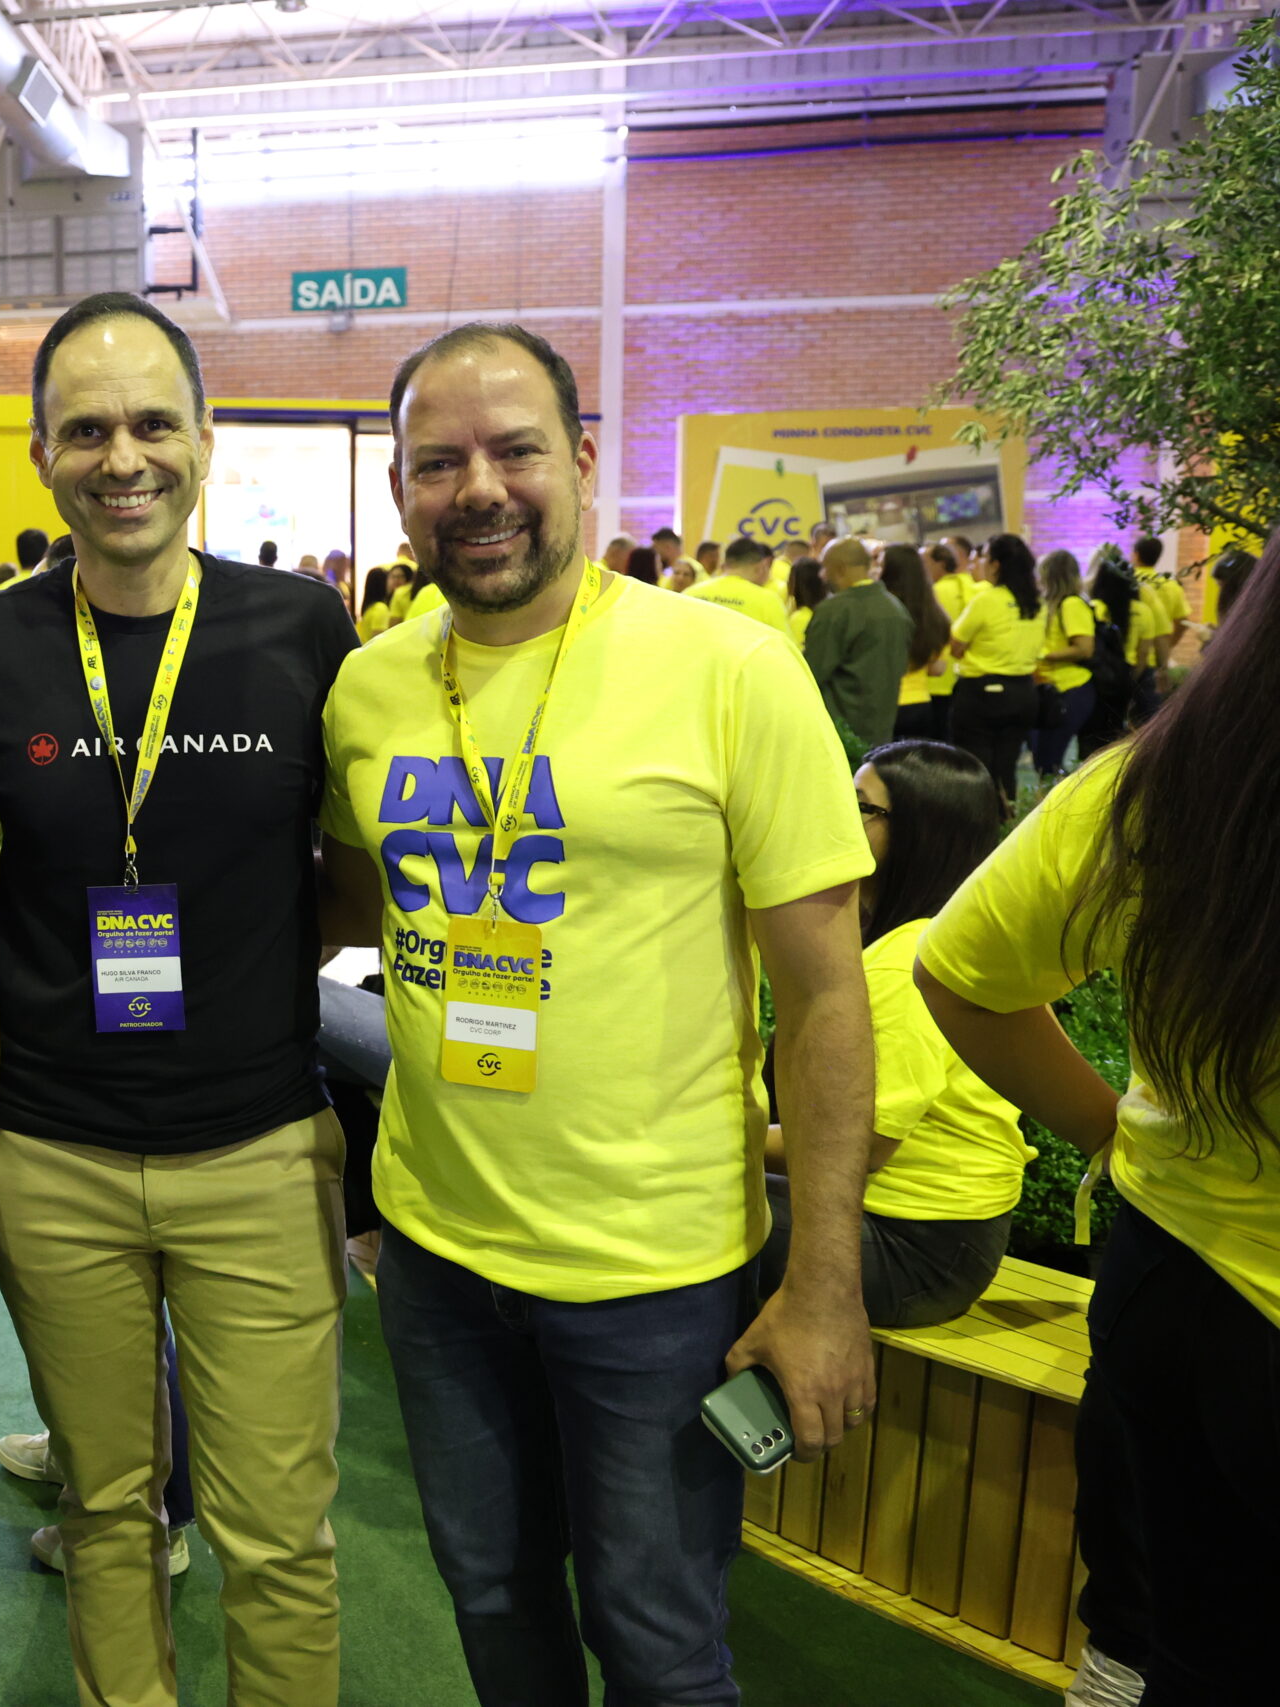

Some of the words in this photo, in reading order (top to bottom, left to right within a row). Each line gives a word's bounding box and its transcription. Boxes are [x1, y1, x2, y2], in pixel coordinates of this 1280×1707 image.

[297, 273, 402, 309] SAÍDA
[772, 428, 820, 438] MINHA
[822, 426, 901, 438] CONQUISTA
[906, 425, 934, 435] CVC
[737, 516, 802, 538] CVC
[71, 738, 126, 757] AIR
[378, 755, 566, 830] DNA
[380, 829, 566, 925] CVC
[395, 927, 448, 965] #Org
[452, 967, 481, 977] Orgulho
[128, 1002, 152, 1011] CVC
[455, 1016, 485, 1026] RODRIGO
[485, 1019, 517, 1030] MARTINEZ
[477, 1058, 502, 1071] CVC
